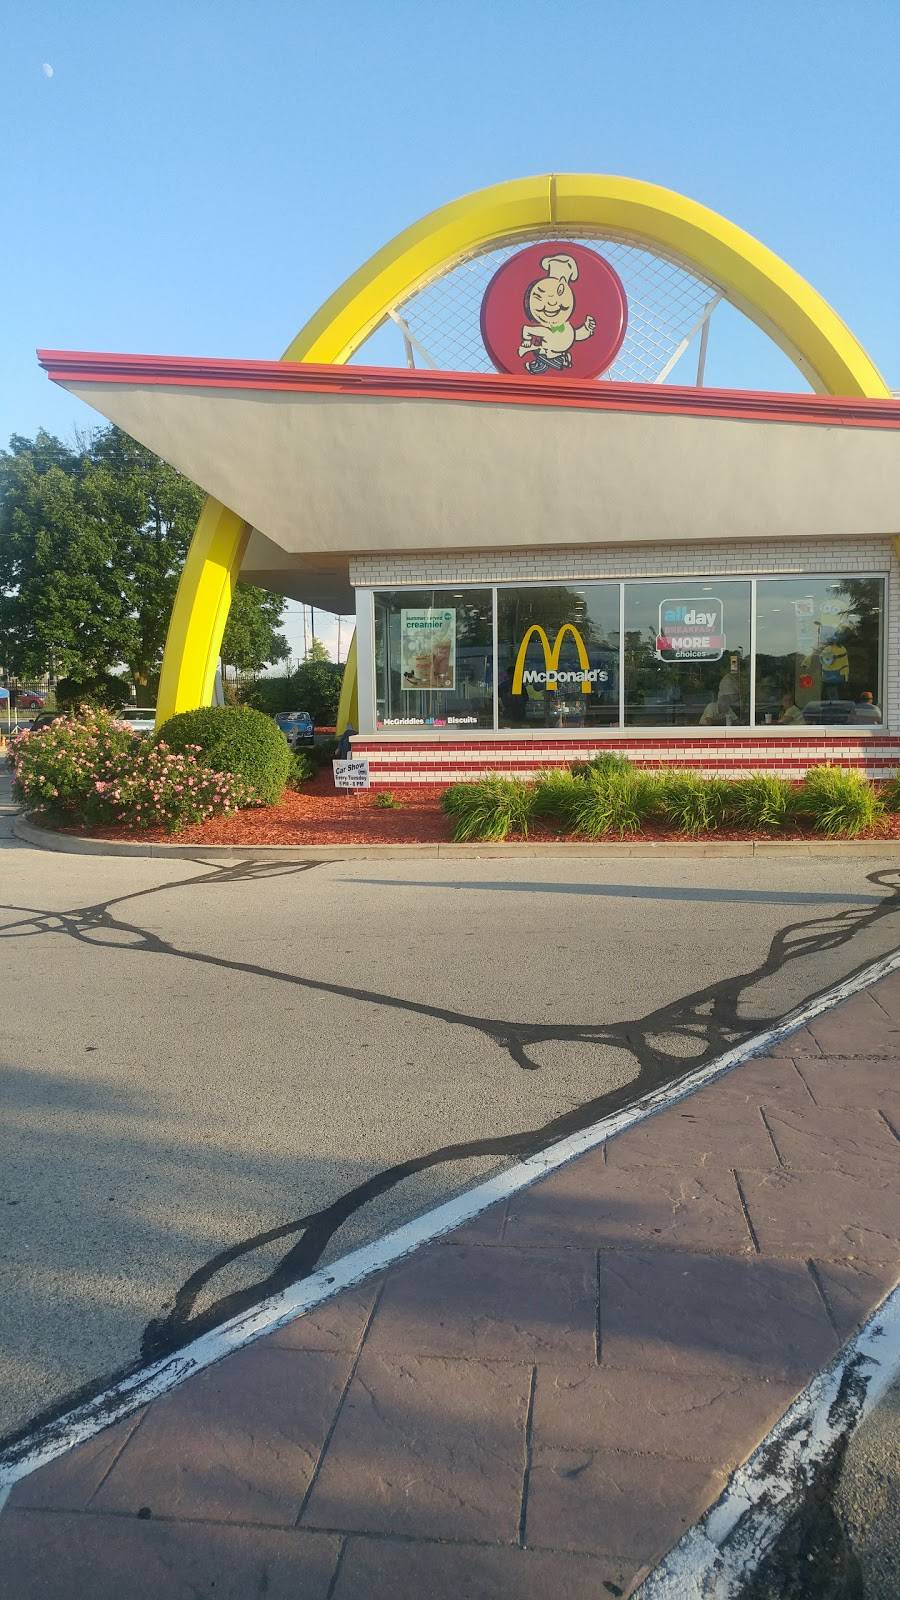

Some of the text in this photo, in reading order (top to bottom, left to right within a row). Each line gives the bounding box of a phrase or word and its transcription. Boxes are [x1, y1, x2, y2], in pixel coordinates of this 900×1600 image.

[406, 620, 443, 629] creamier
[671, 637, 711, 649] MORE
[675, 650, 707, 658] choices
[523, 669, 609, 683] McDonald's
[383, 717, 425, 726] McGriddles
[447, 716, 478, 724] Biscuits
[348, 763, 365, 772] Show
